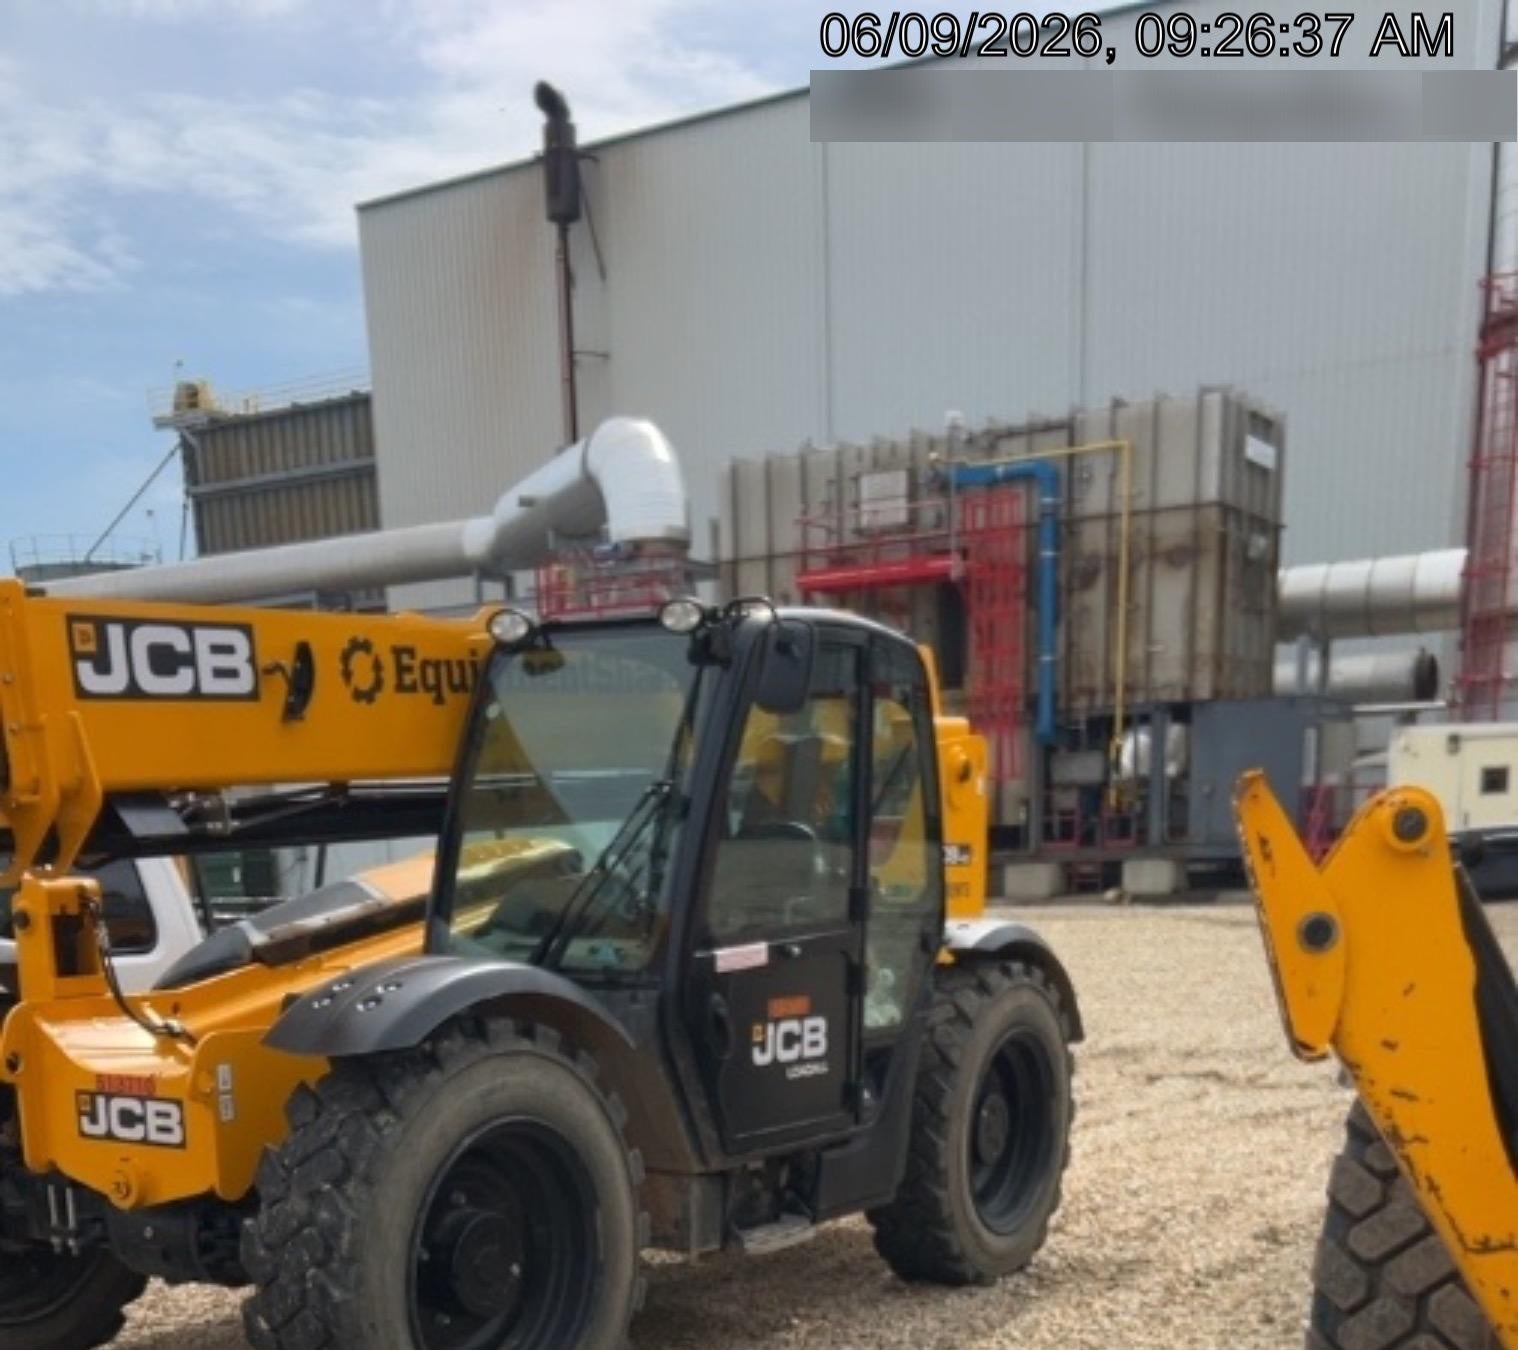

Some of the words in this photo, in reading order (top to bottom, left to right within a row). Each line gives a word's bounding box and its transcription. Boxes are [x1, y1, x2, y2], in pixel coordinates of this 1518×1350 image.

[75, 622, 257, 697] JCB
[752, 1016, 829, 1066] JCB
[79, 1094, 184, 1145] JCB
